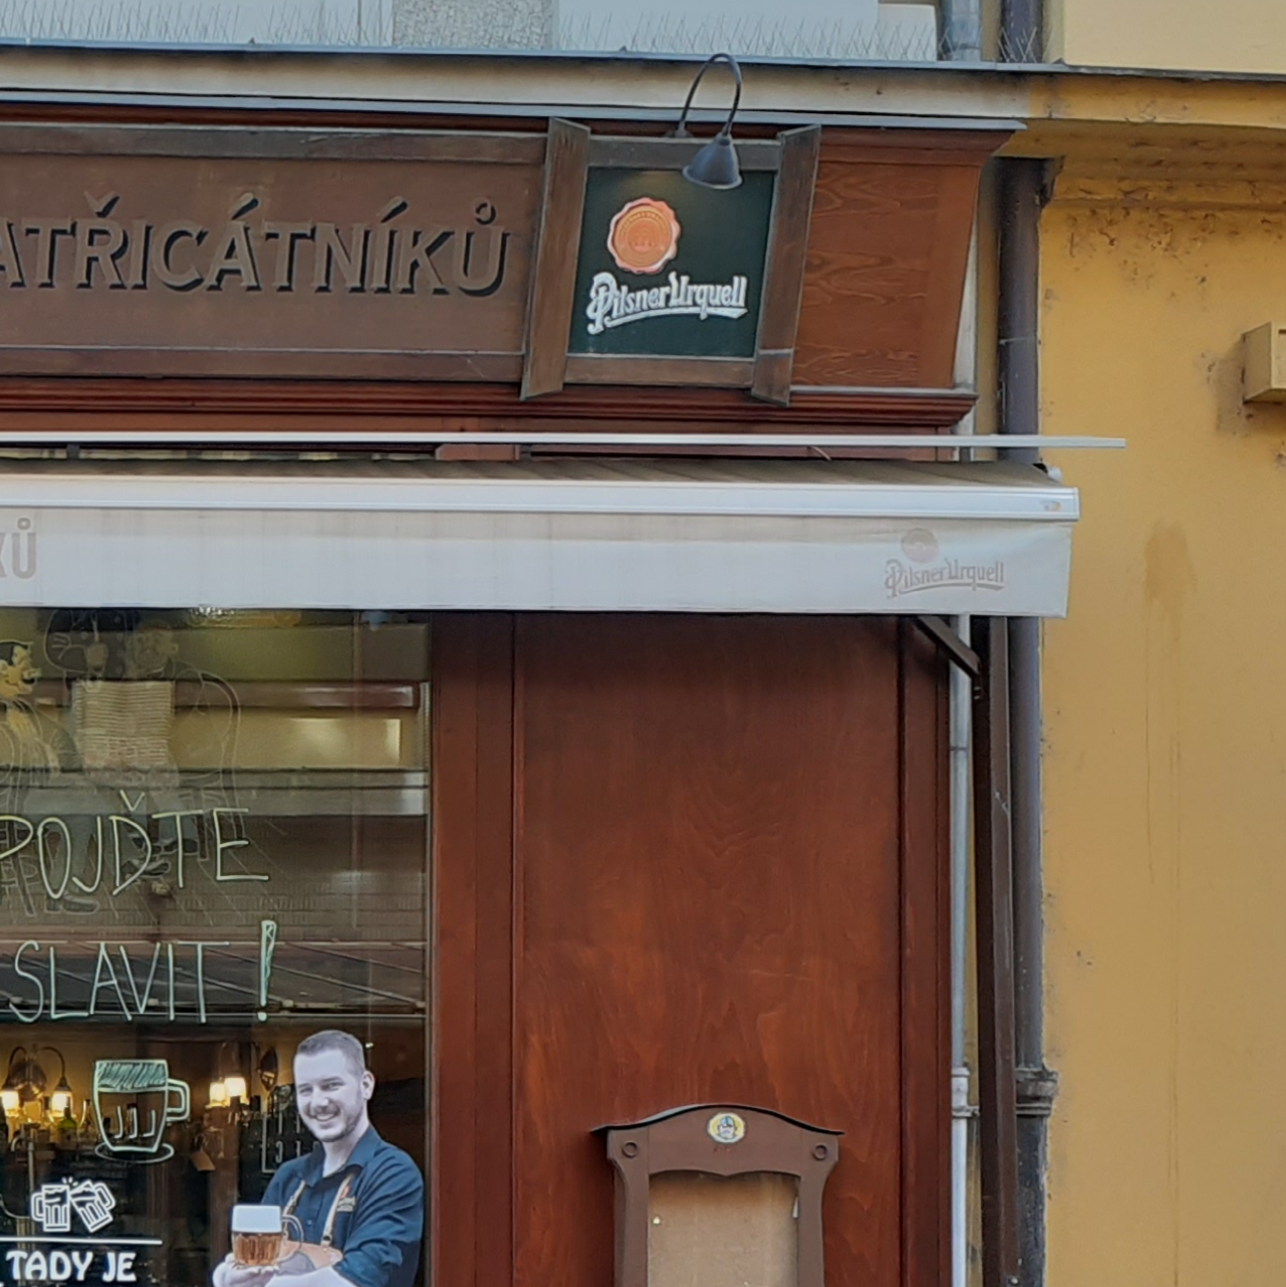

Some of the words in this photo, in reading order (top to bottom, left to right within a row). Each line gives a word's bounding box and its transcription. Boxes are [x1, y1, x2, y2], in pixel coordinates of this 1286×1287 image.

[586, 272, 670, 335] Pilsner
[668, 271, 747, 320] Urquell
[884, 558, 946, 599] Pilsner
[944, 558, 1004, 591] Urquell
[9, 940, 229, 1023] SLAVIT
[6, 1251, 93, 1281] TADY
[102, 1252, 137, 1282] JE
